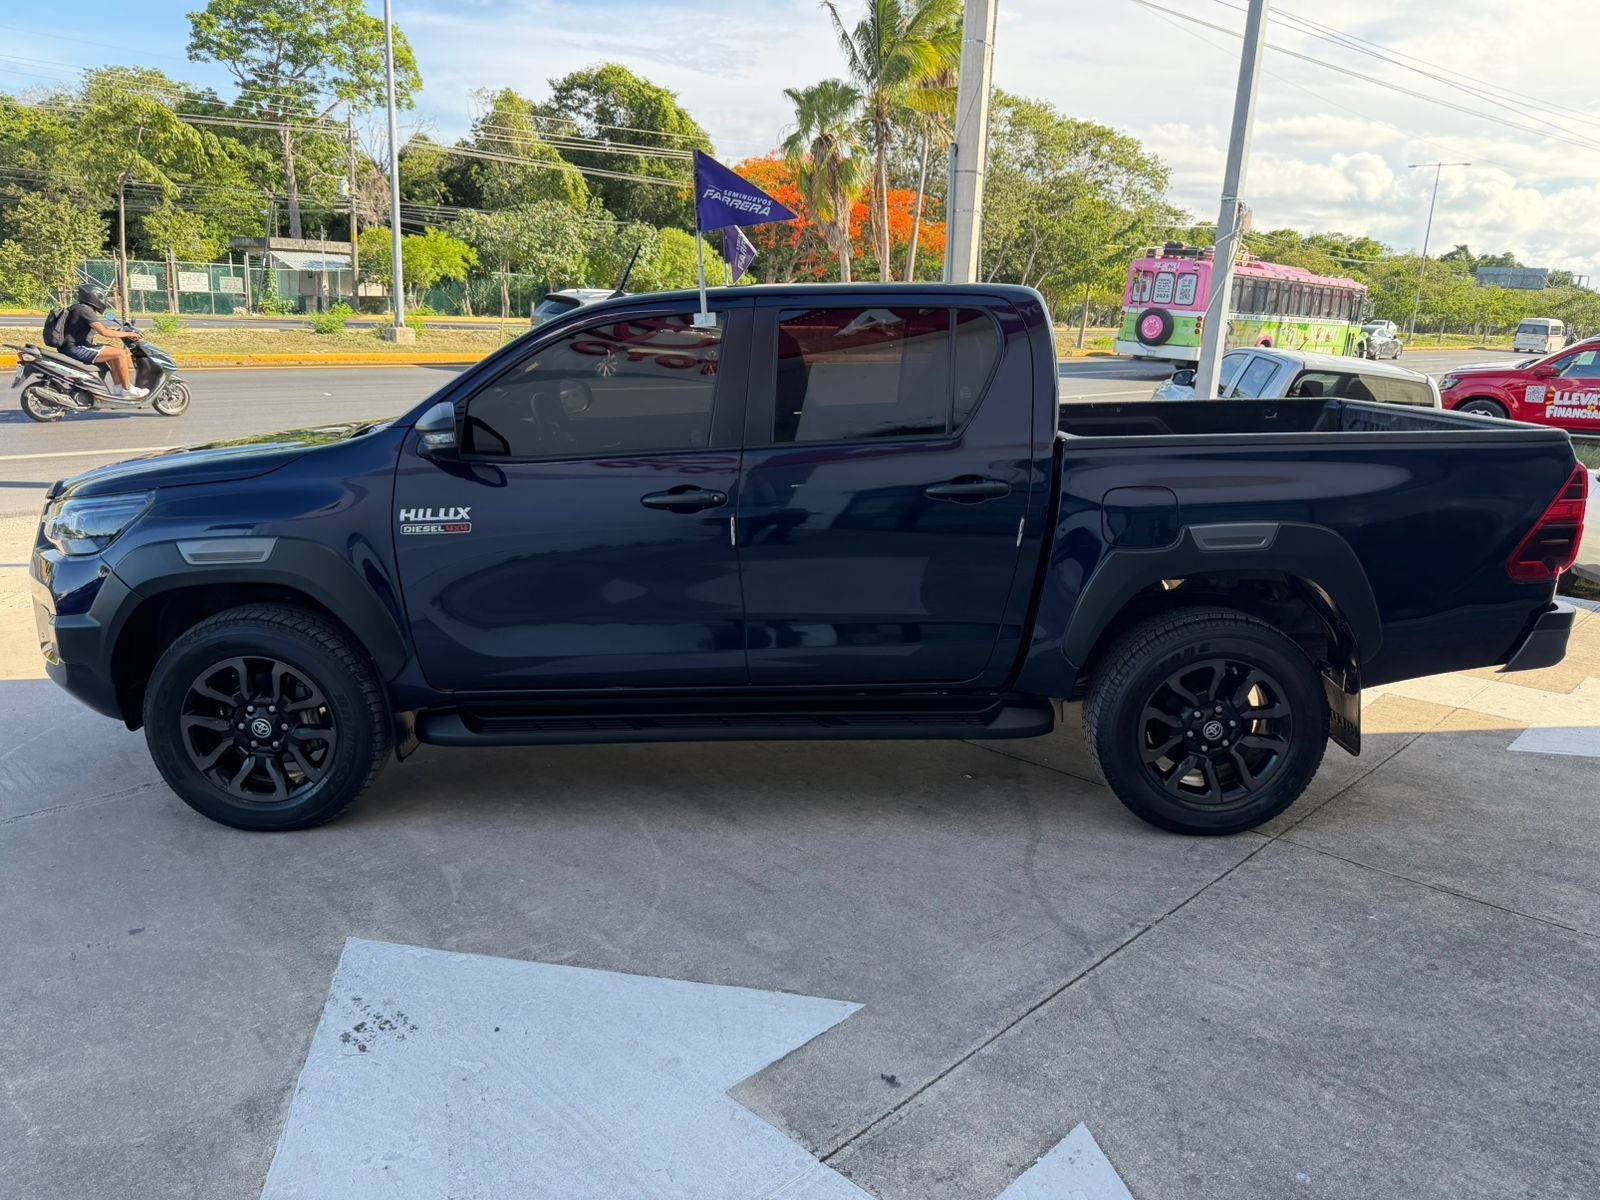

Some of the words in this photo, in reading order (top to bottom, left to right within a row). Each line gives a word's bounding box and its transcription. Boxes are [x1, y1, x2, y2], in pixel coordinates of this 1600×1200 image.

[702, 189, 771, 216] FARRERA
[723, 189, 772, 206] SEMINUEVOS
[399, 506, 471, 521] HILUX
[403, 525, 445, 533] DIESEL
